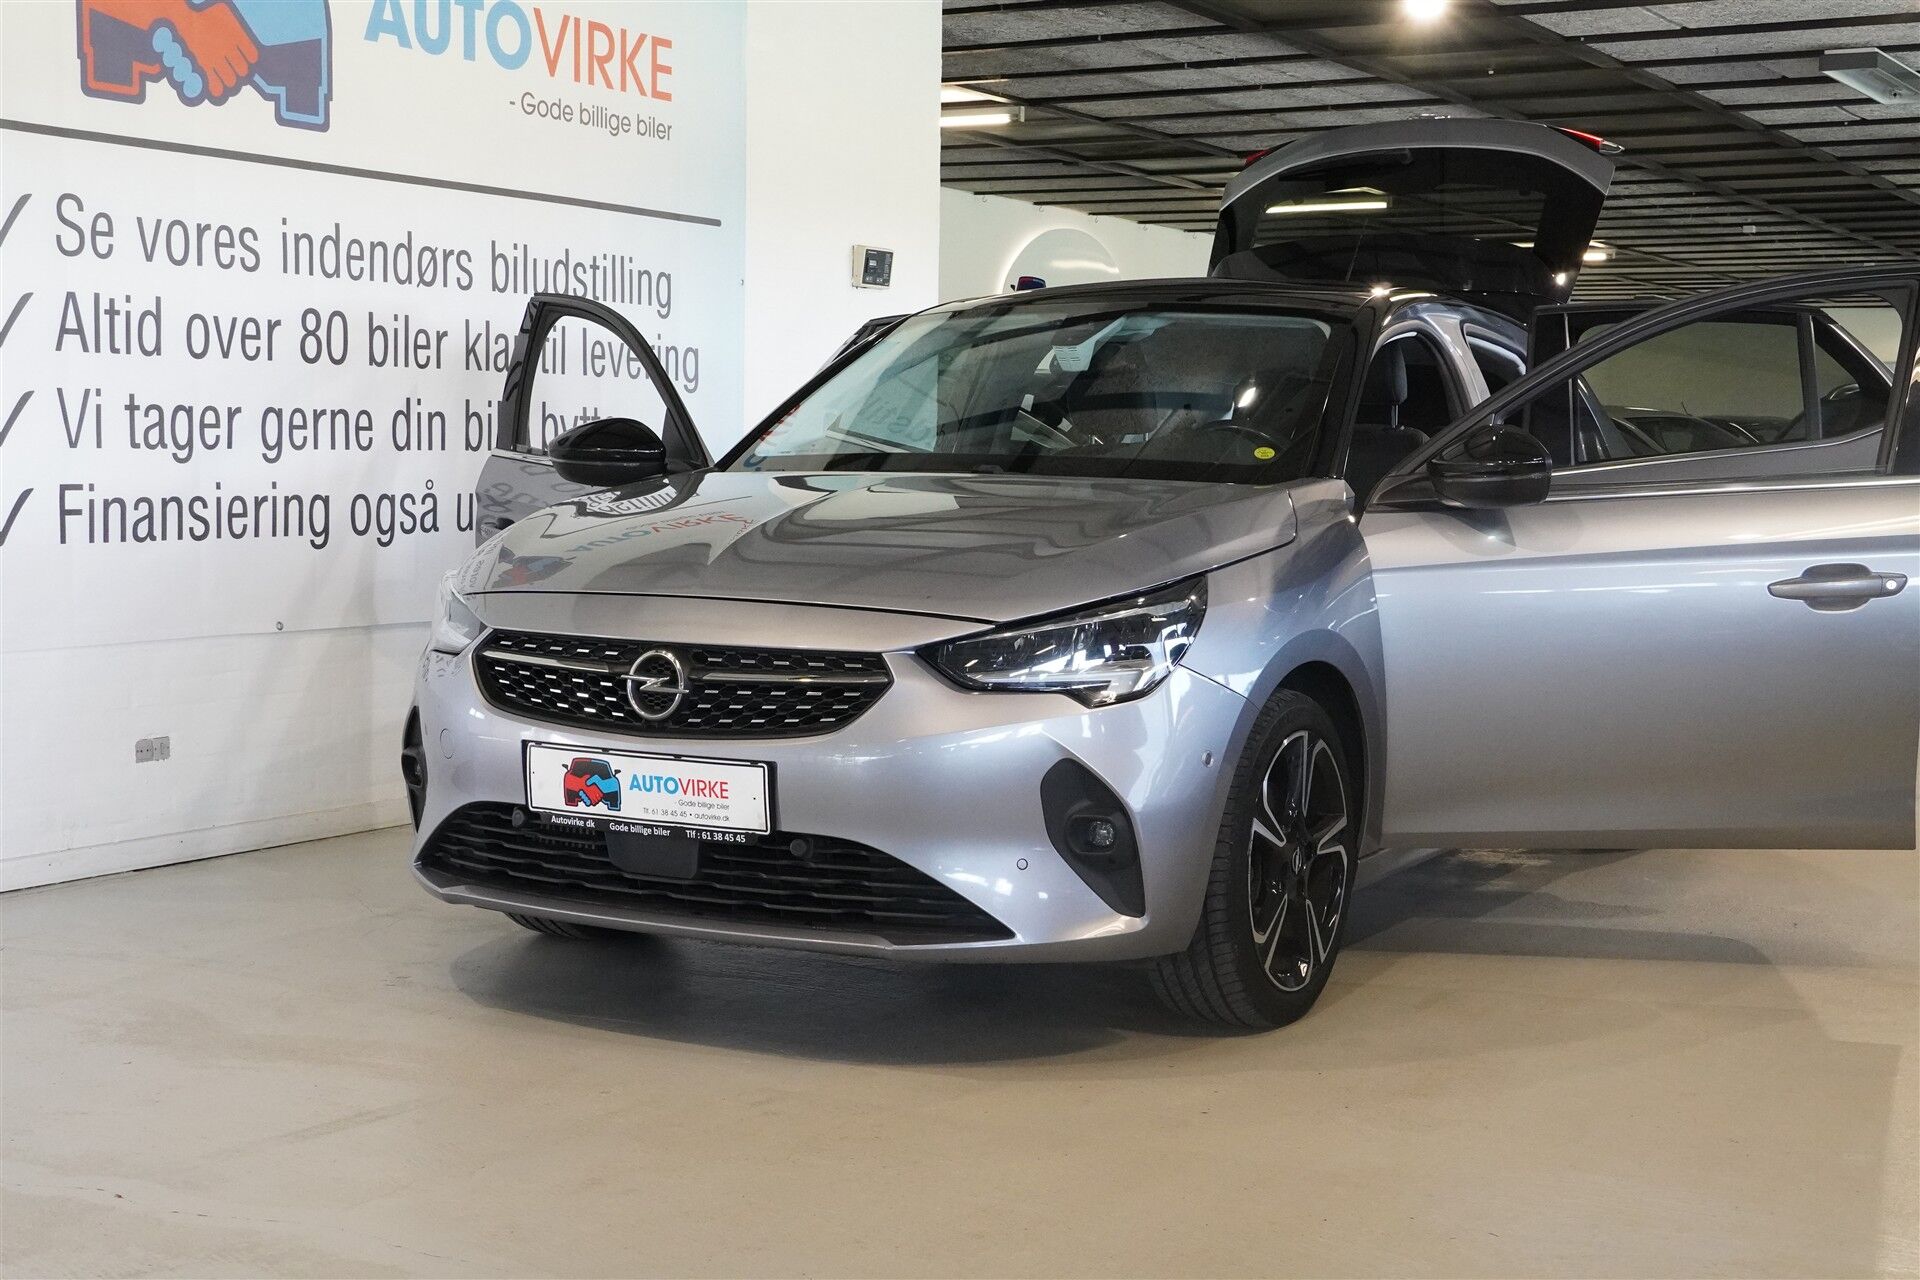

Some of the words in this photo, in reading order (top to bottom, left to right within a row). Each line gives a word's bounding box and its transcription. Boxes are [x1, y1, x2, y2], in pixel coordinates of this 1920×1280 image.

[363, 0, 673, 102] AUTOVIRKE
[521, 91, 574, 122] Gode
[579, 102, 632, 137] billige
[636, 113, 673, 141] biler
[55, 192, 114, 260] Se
[136, 216, 261, 273] vores
[281, 216, 474, 292] indendørs
[490, 239, 672, 320] biludstilling
[55, 290, 162, 358] Altid
[185, 312, 282, 362] over
[299, 307, 349, 366] 80
[367, 311, 449, 370] biler
[582, 327, 699, 394] leveing
[56, 386, 103, 449] Vi
[123, 392, 243, 465] tager
[260, 406, 374, 465] gerne
[391, 396, 447, 452] din
[58, 480, 331, 551] Finansiering
[349, 478, 440, 548] også
[629, 773, 729, 799] AUTOVIRKE
[551, 815, 585, 827] Autovirke
[586, 819, 596, 828] dk
[609, 822, 629, 832] Gode
[630, 825, 653, 836] billige
[653, 828, 671, 837] biler
[701, 831, 712, 840] 61
[713, 832, 723, 841] 38
[724, 833, 735, 842] 45
[736, 834, 746, 843] 45
